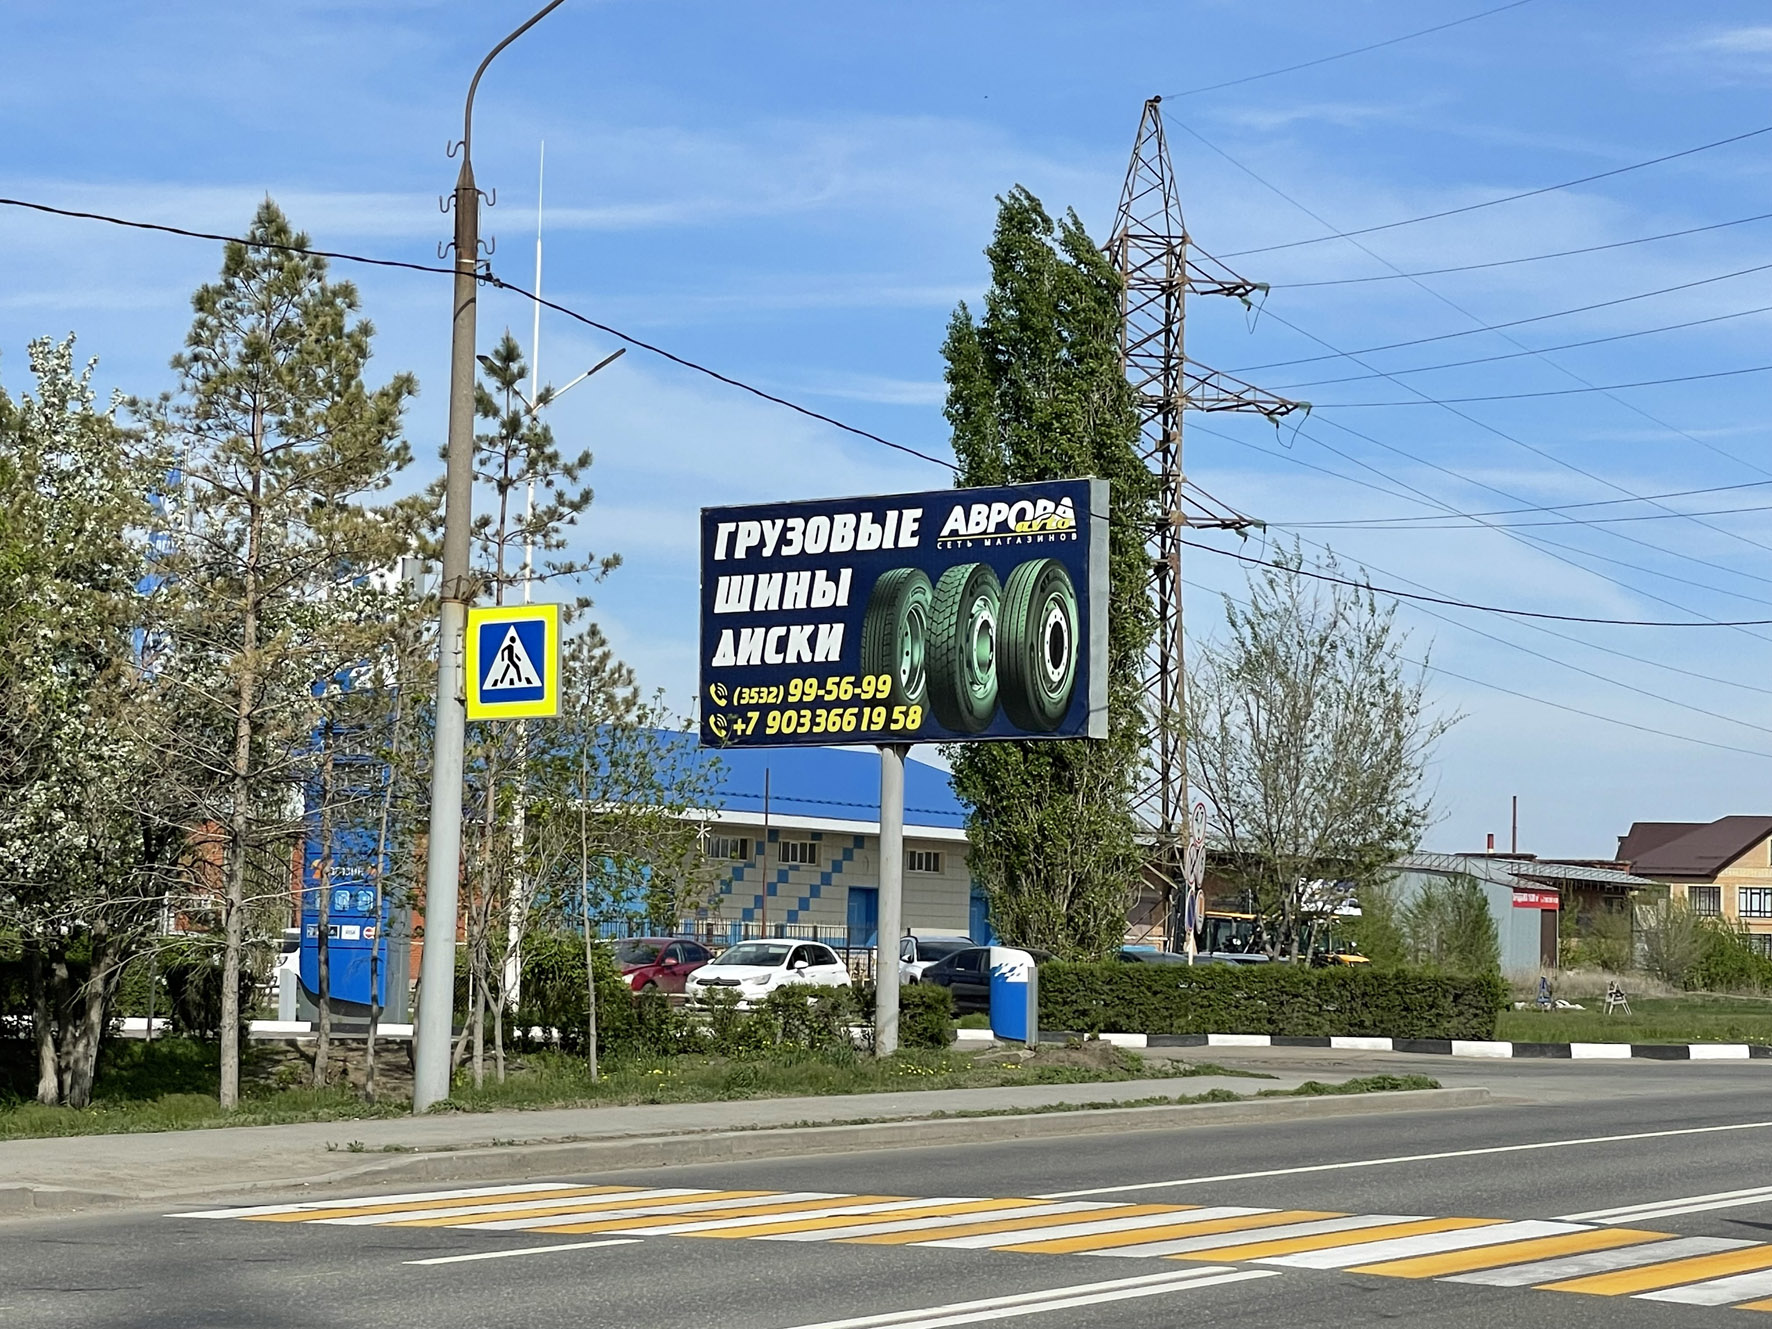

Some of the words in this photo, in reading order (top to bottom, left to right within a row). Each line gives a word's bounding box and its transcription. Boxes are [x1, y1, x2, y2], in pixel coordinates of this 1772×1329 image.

[714, 507, 923, 561] ГРУЗОВЫЕ
[939, 496, 1077, 537] АВРОРА
[1014, 514, 1073, 534] avto
[936, 540, 973, 550] СЕТЬ
[984, 532, 1077, 547] МАГАЗИНОВ
[713, 567, 853, 614] ШИНЫ
[711, 622, 845, 667] ДИСКИ
[733, 686, 784, 705] (3532)
[787, 674, 892, 703] 99-56-99
[733, 711, 760, 735] +7
